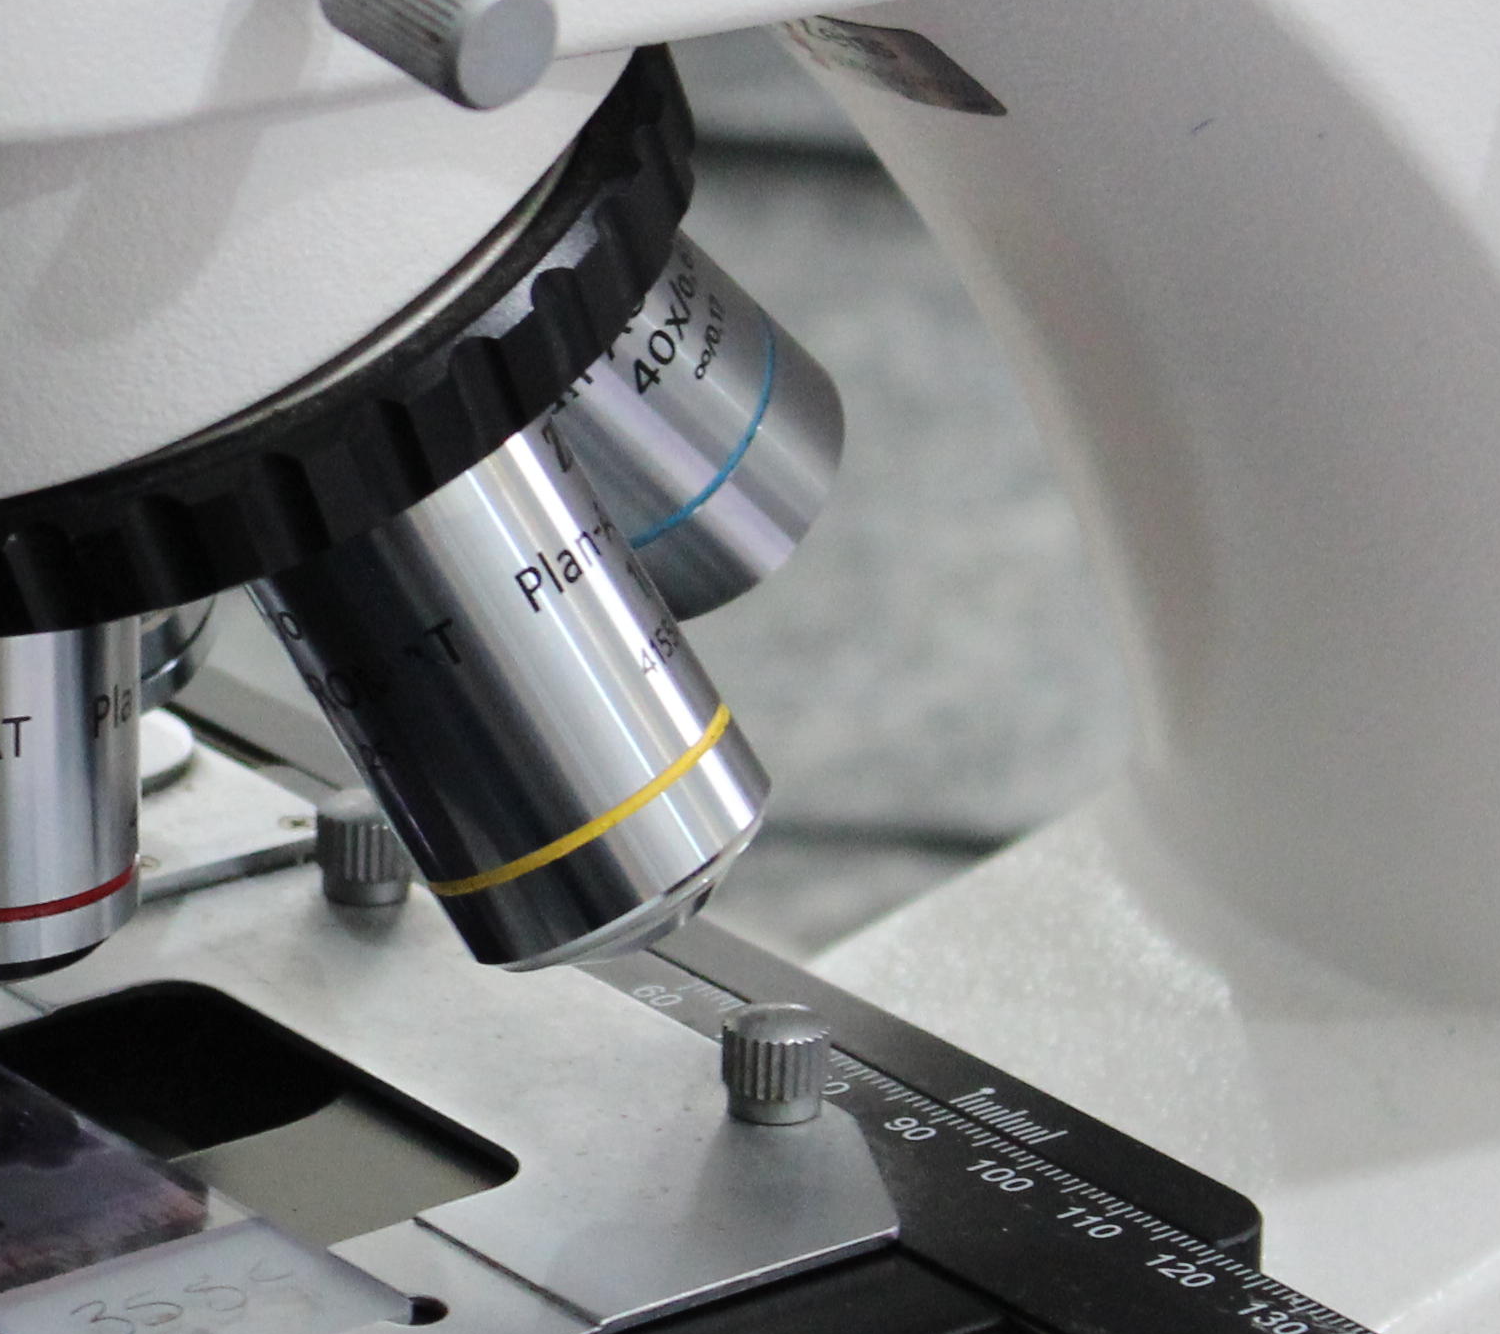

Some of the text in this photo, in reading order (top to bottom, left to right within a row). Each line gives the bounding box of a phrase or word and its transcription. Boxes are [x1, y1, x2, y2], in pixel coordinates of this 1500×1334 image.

[632, 984, 684, 1008] 60
[883, 1116, 937, 1142] 90
[966, 1158, 1035, 1192] 100
[1056, 1206, 1124, 1239] 110
[1145, 1253, 1216, 1288] 120
